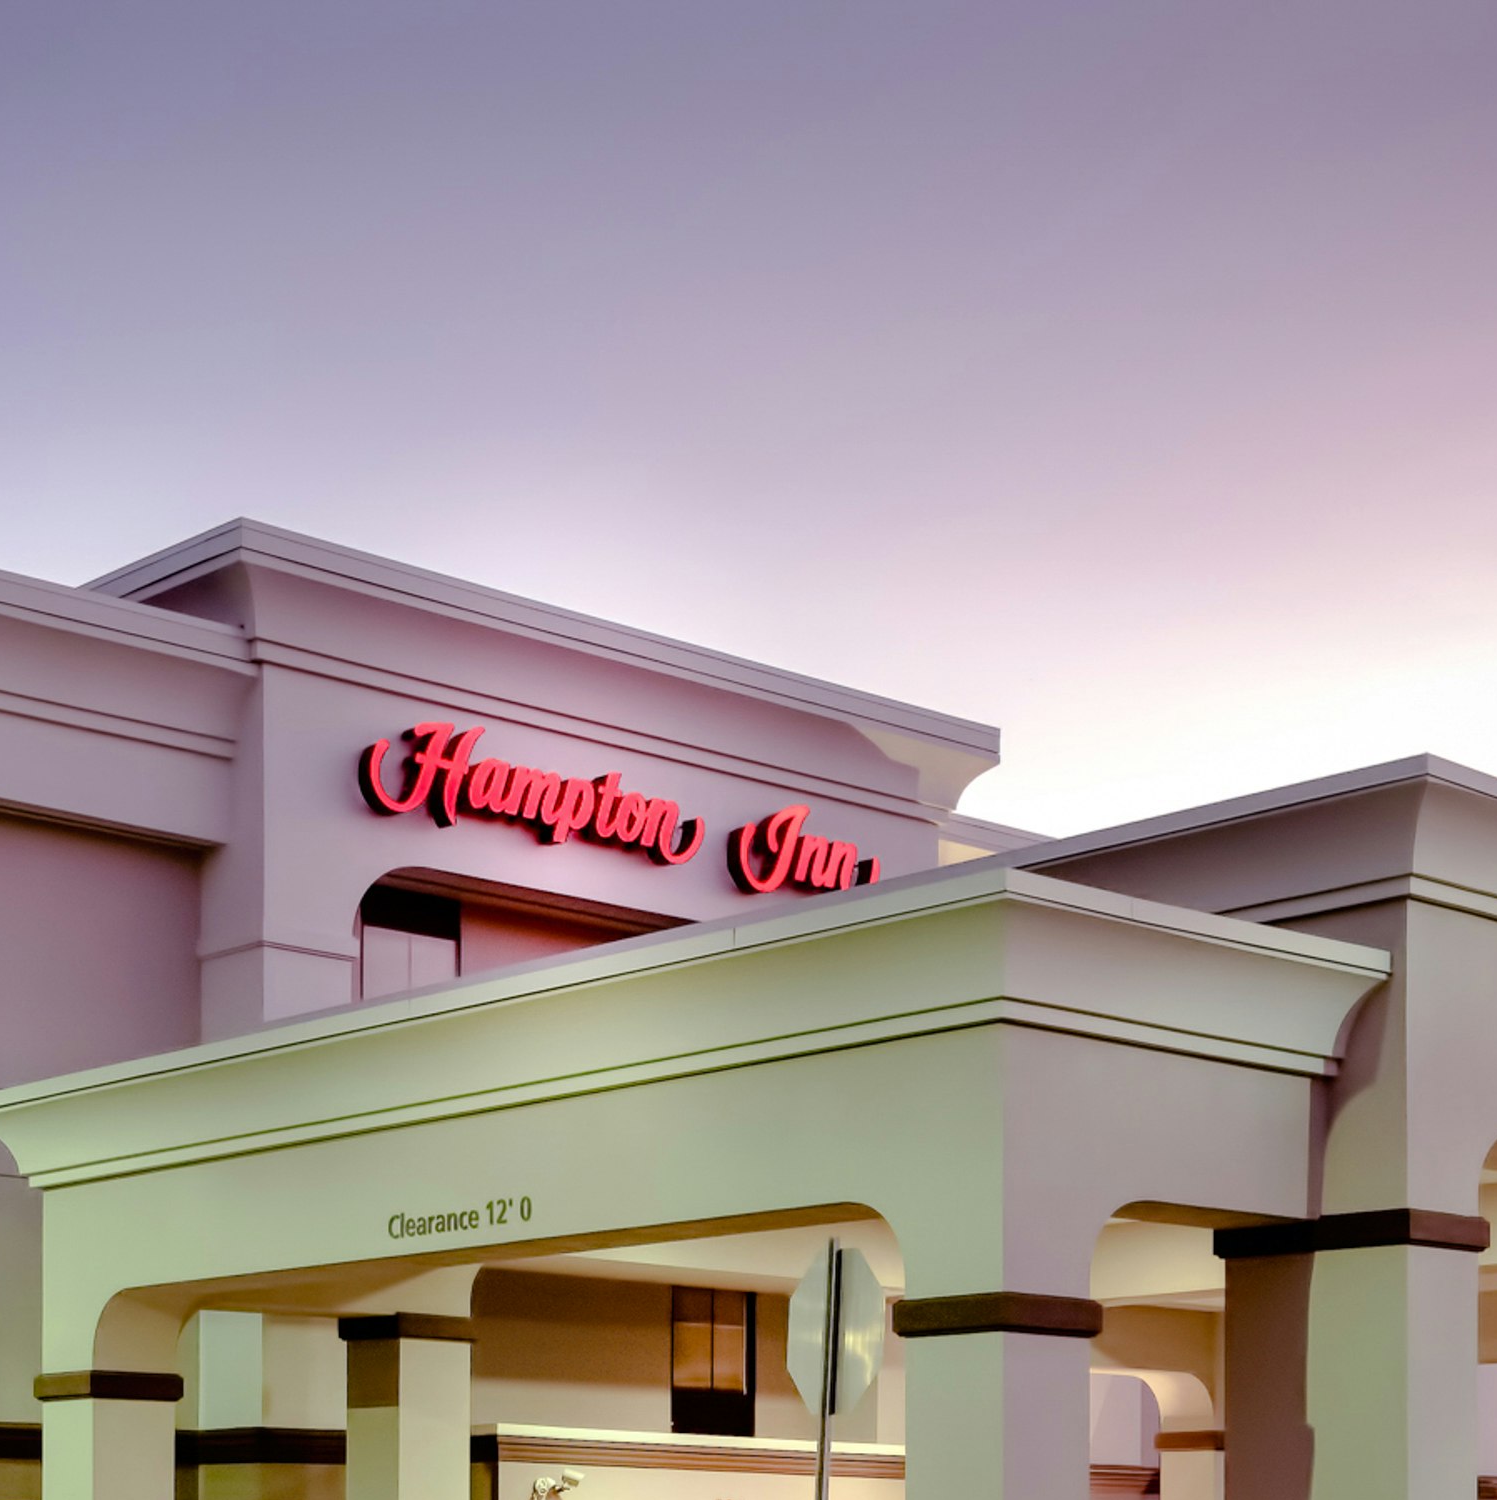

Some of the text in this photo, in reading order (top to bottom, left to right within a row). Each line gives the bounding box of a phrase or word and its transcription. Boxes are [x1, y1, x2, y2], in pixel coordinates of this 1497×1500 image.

[359, 721, 881, 893] Hampton Inn
[388, 1209, 480, 1239] Clearance
